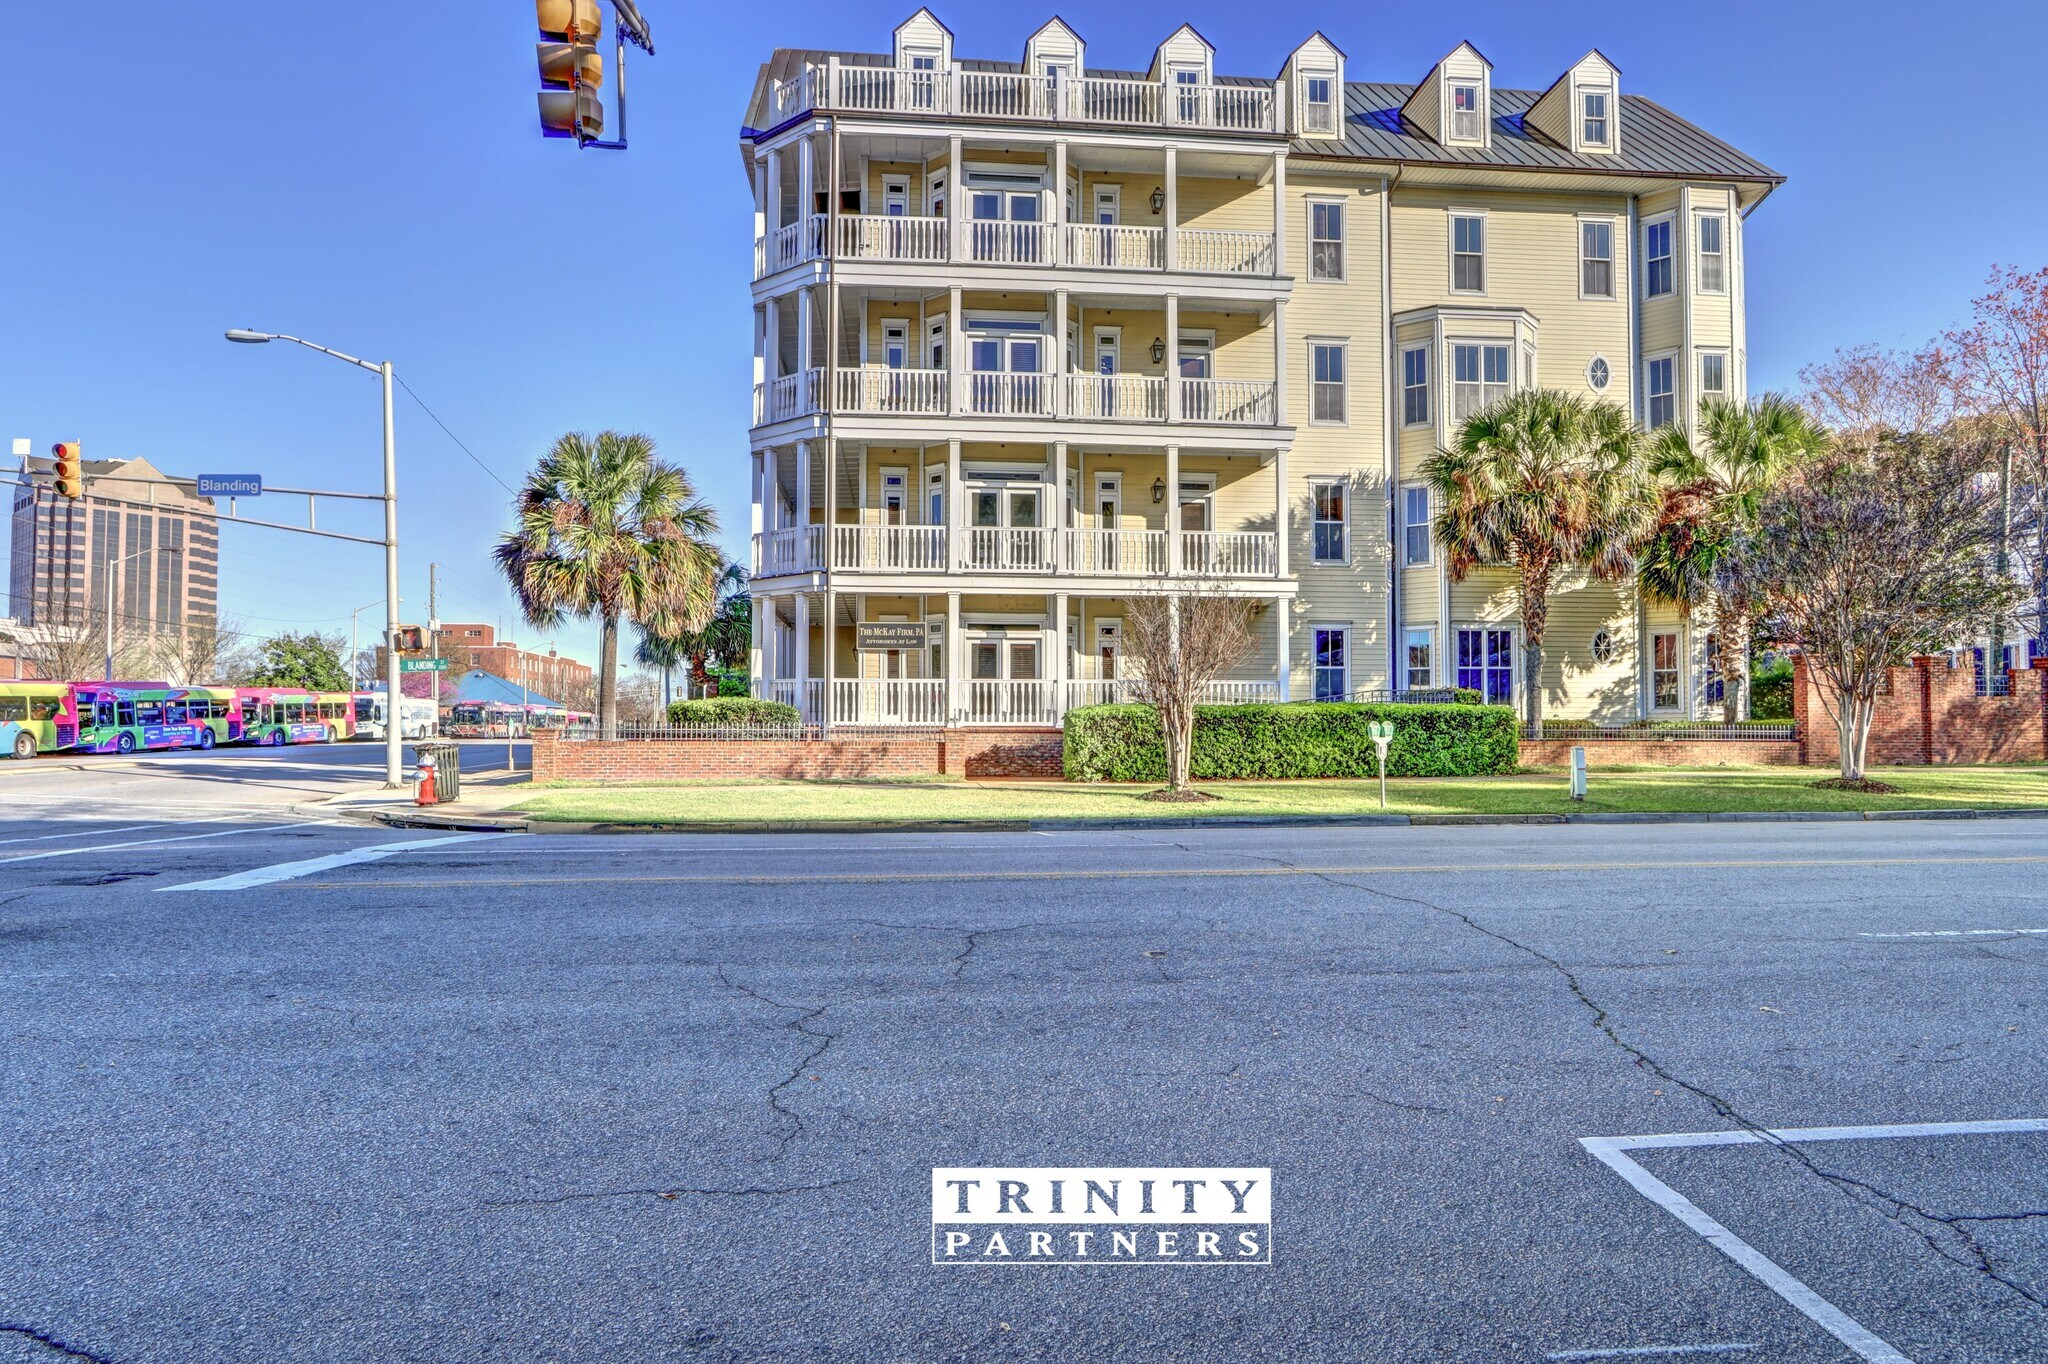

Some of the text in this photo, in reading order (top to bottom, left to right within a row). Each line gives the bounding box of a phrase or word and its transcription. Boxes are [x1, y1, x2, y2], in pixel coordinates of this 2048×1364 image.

[200, 479, 259, 494] Blanding
[860, 627, 873, 636] THE
[896, 627, 915, 637] FIRM,
[915, 627, 924, 636] PA
[407, 661, 436, 670] BLANDING
